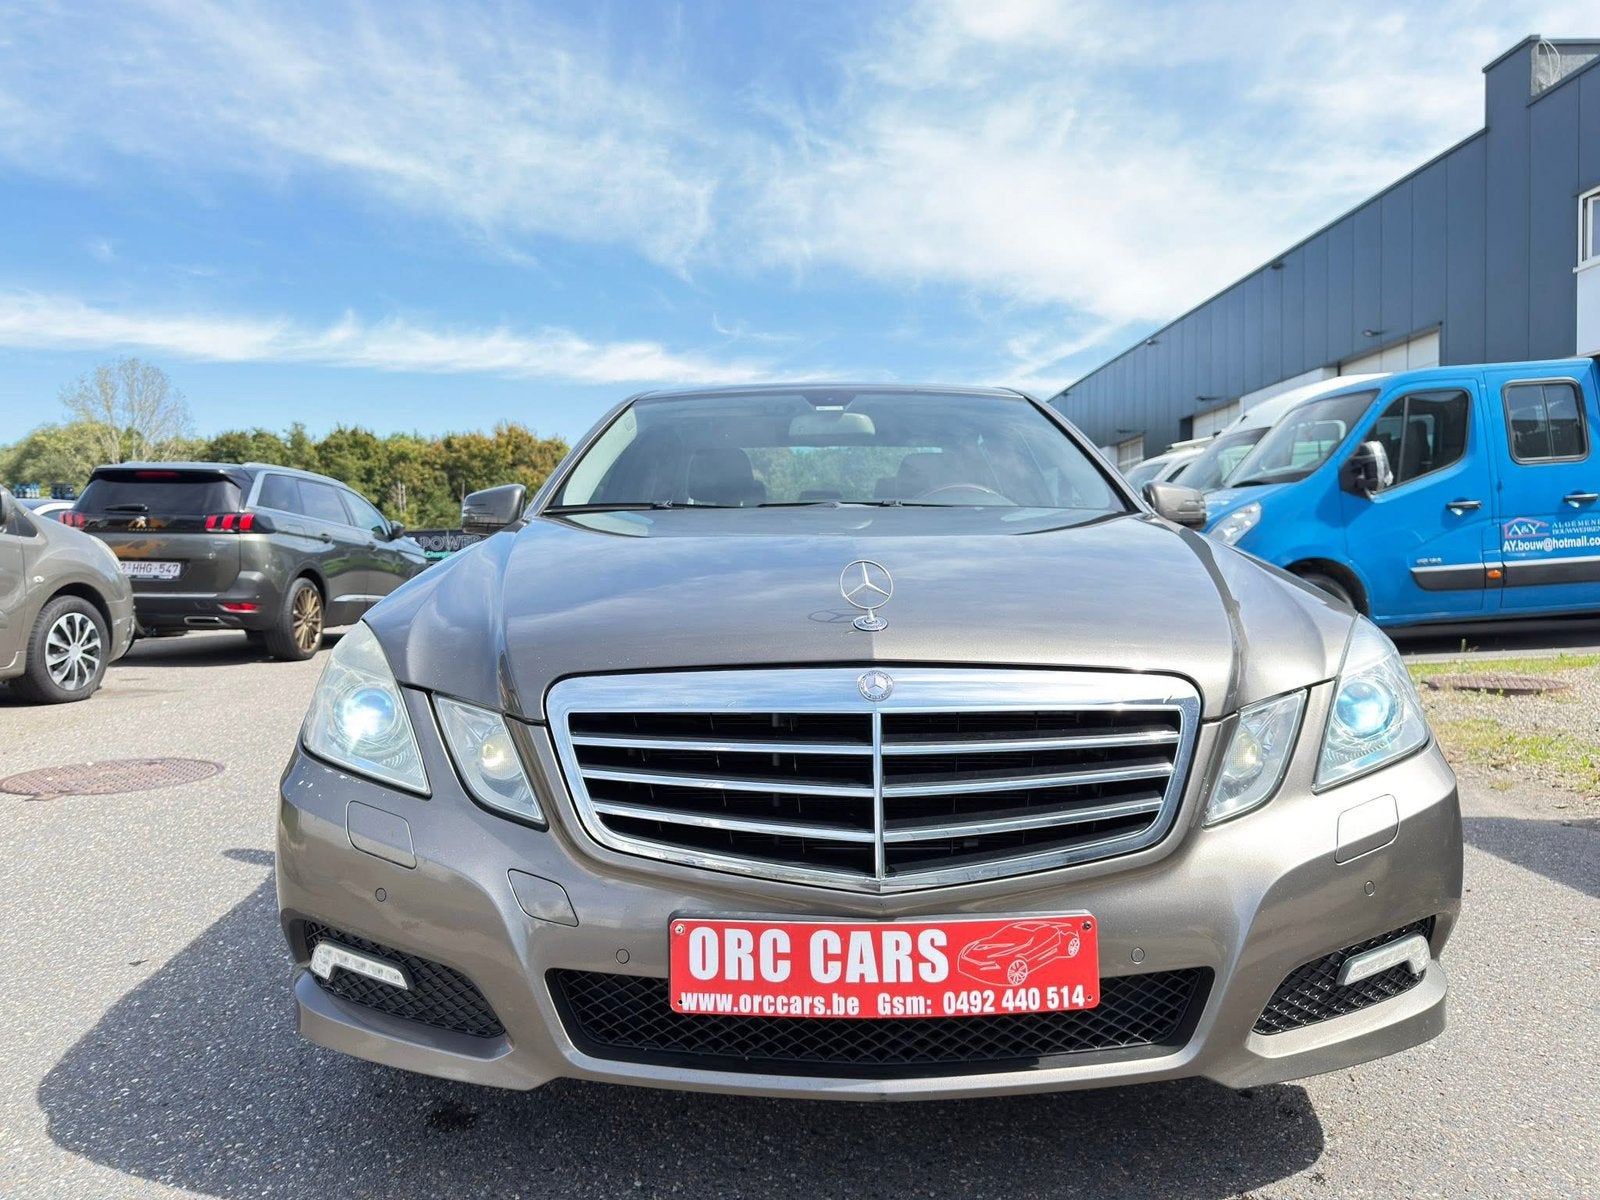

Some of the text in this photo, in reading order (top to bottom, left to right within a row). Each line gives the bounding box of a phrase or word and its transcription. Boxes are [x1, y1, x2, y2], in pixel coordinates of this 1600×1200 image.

[1508, 523, 1540, 537] A&Y
[689, 927, 949, 984] ORC CARS
[681, 984, 1085, 1016] www.orccars.be Gsm: 0492 440 514
